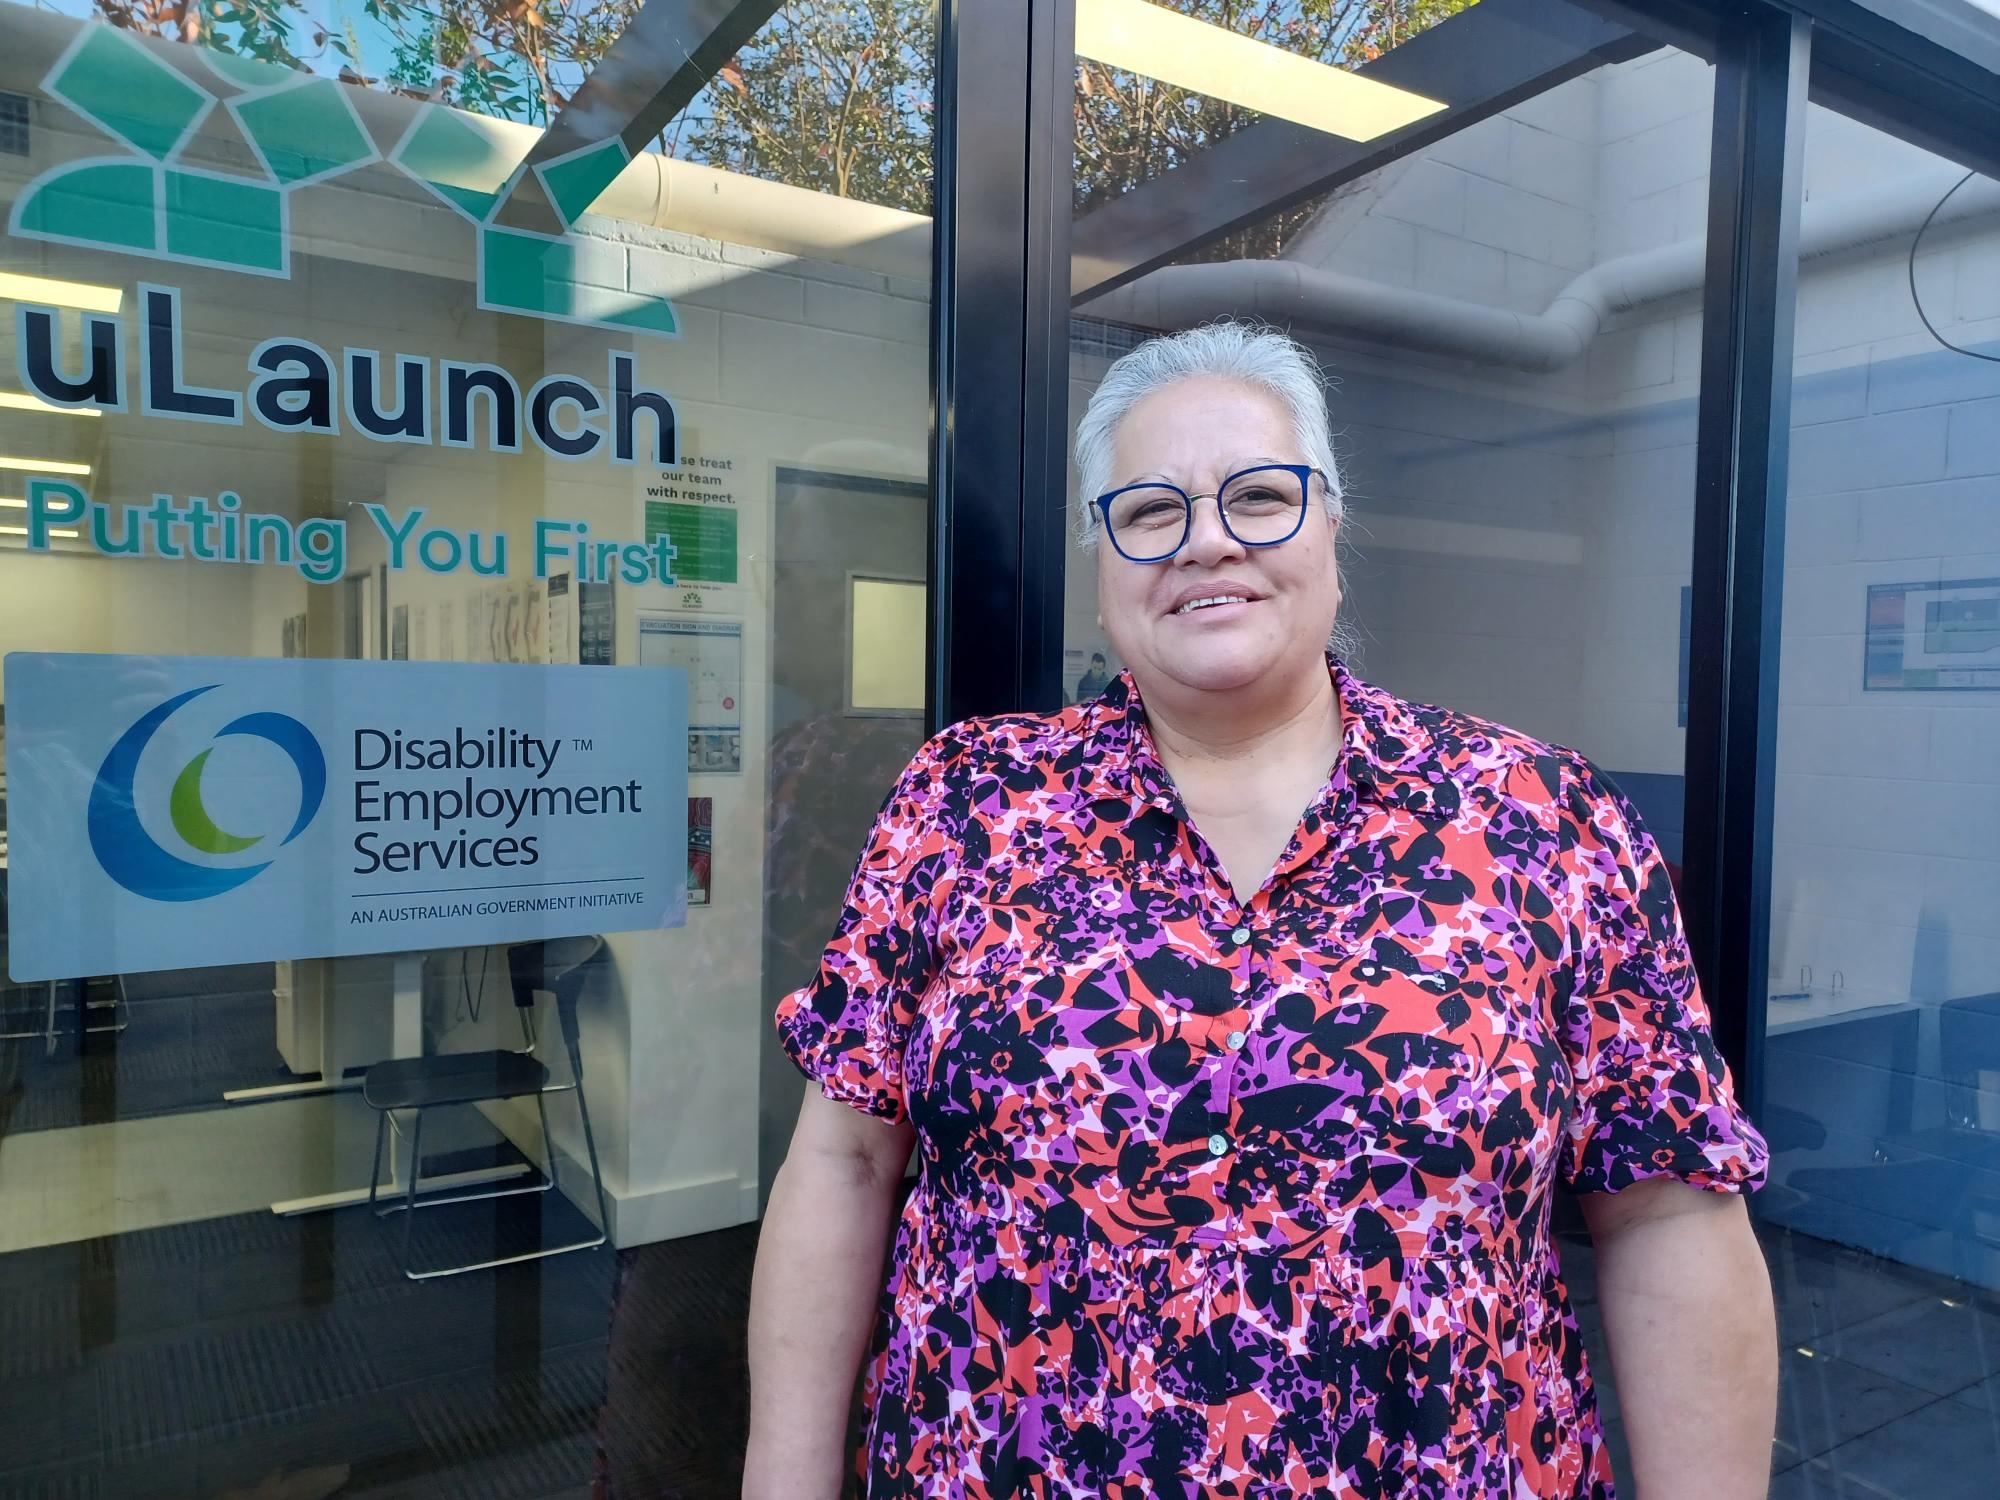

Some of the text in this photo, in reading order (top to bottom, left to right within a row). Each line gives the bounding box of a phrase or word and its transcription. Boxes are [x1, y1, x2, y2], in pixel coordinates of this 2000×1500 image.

[22, 287, 681, 467] uLaunch
[661, 471, 722, 486] our team
[699, 457, 733, 470] treat
[646, 485, 736, 504] with respect.
[30, 480, 344, 583] Putting
[371, 507, 505, 576] You
[535, 519, 678, 586] First
[354, 727, 562, 780] Disability
[354, 776, 643, 831] Employment
[353, 828, 539, 874] Services
[350, 891, 644, 924] AN AUSTRALIAN GOVERNMENT INITIATIVE
